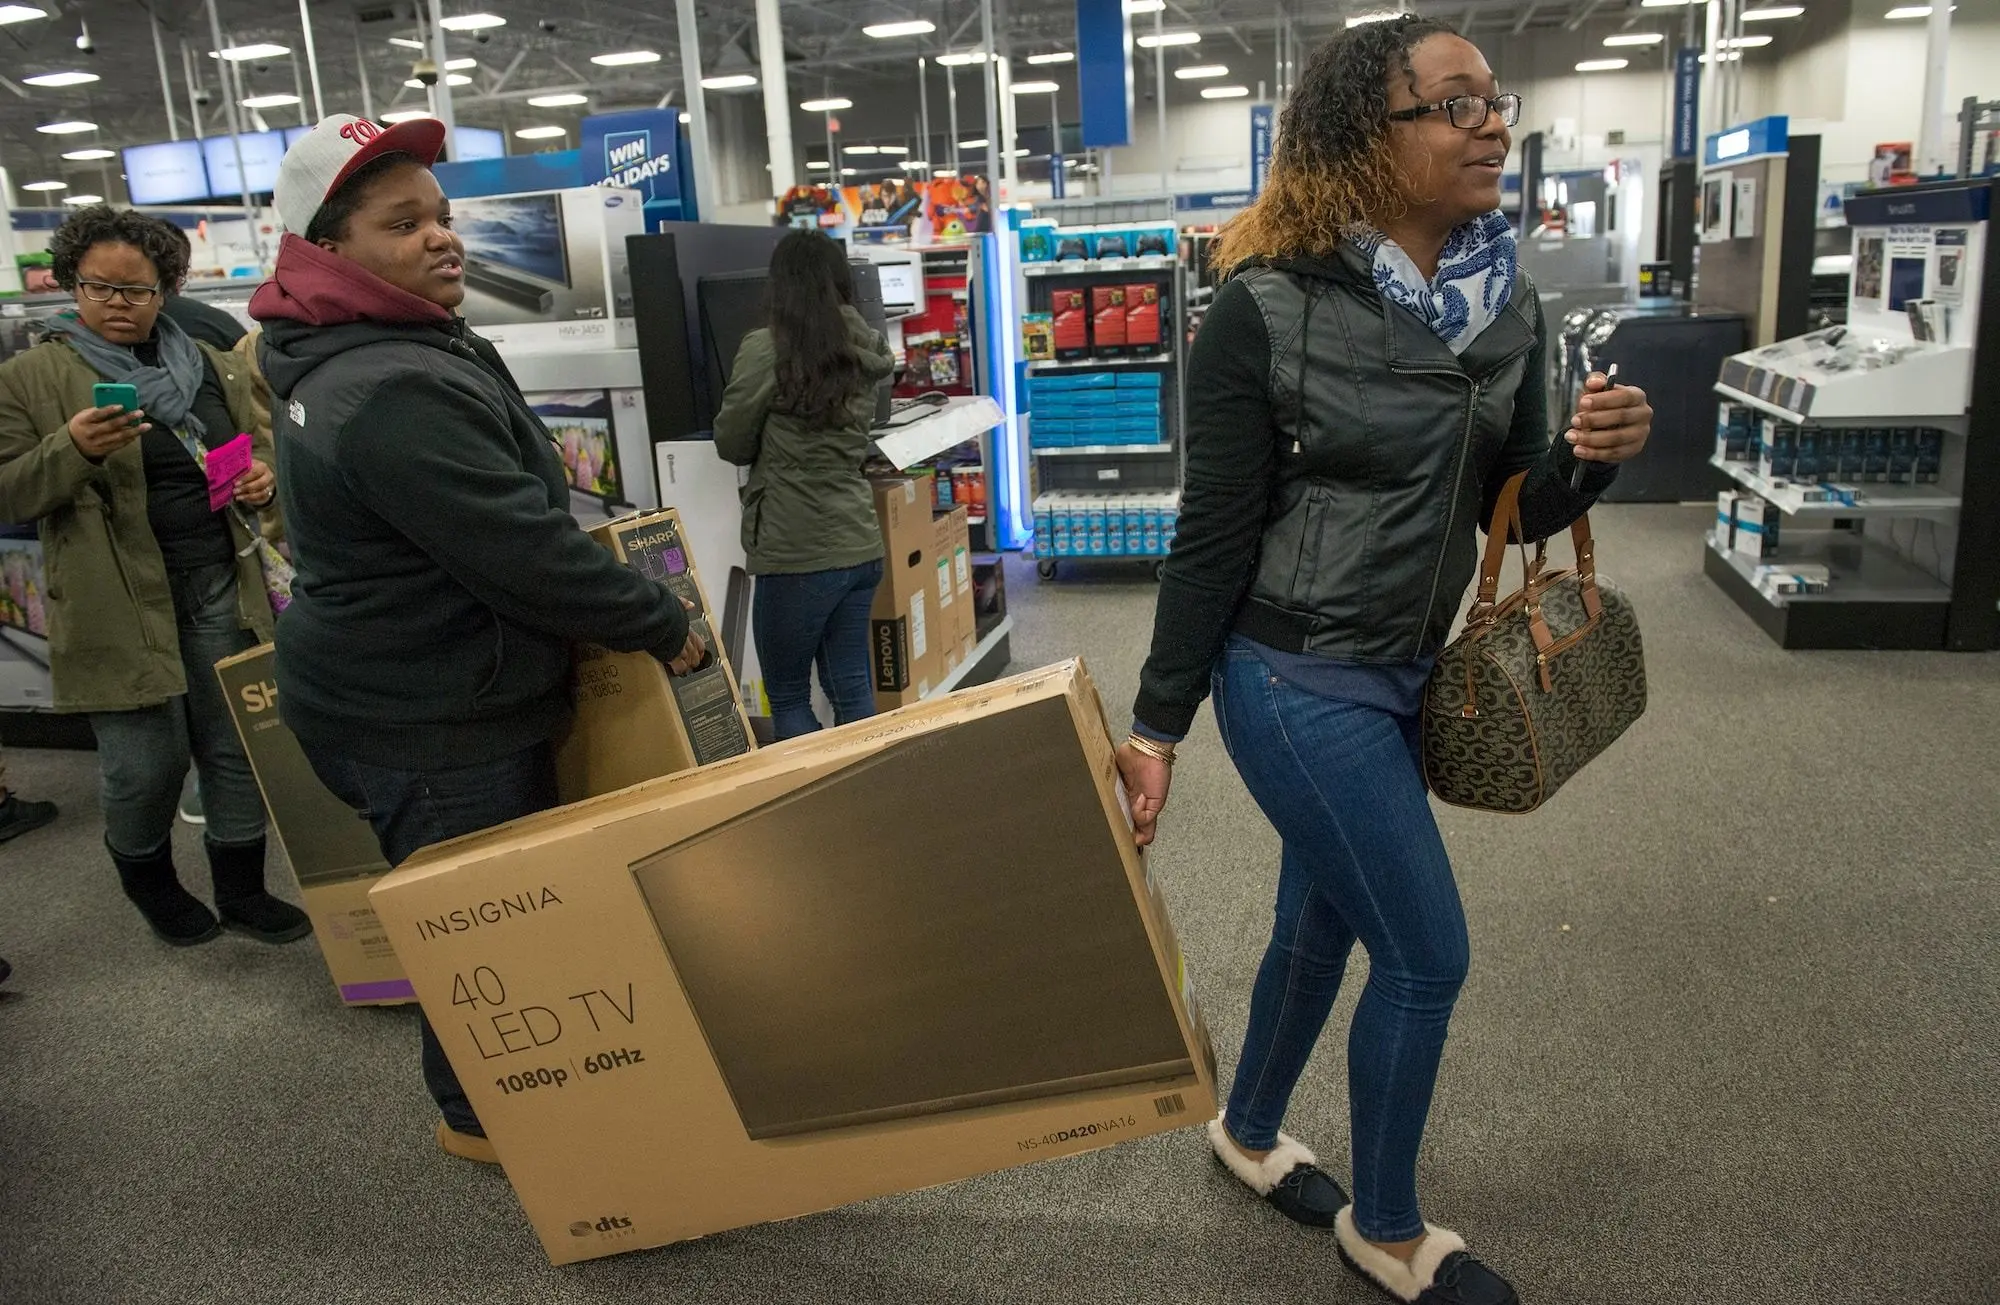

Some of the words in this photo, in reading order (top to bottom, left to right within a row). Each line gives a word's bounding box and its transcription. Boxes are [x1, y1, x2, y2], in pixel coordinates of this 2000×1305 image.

[590, 153, 671, 188] OLIDAYS
[609, 138, 646, 166] WIN
[627, 530, 674, 551] SHARP
[880, 625, 896, 687] Lenovo
[416, 887, 563, 941] INSIGNIA
[452, 966, 506, 1011] 40
[466, 1006, 562, 1060] LED
[568, 983, 635, 1032] TV
[495, 1067, 568, 1095] 1080p
[584, 1048, 646, 1075] 60Hz
[1017, 1114, 1137, 1151] NS-40D420NA16
[595, 1216, 632, 1232] dts
